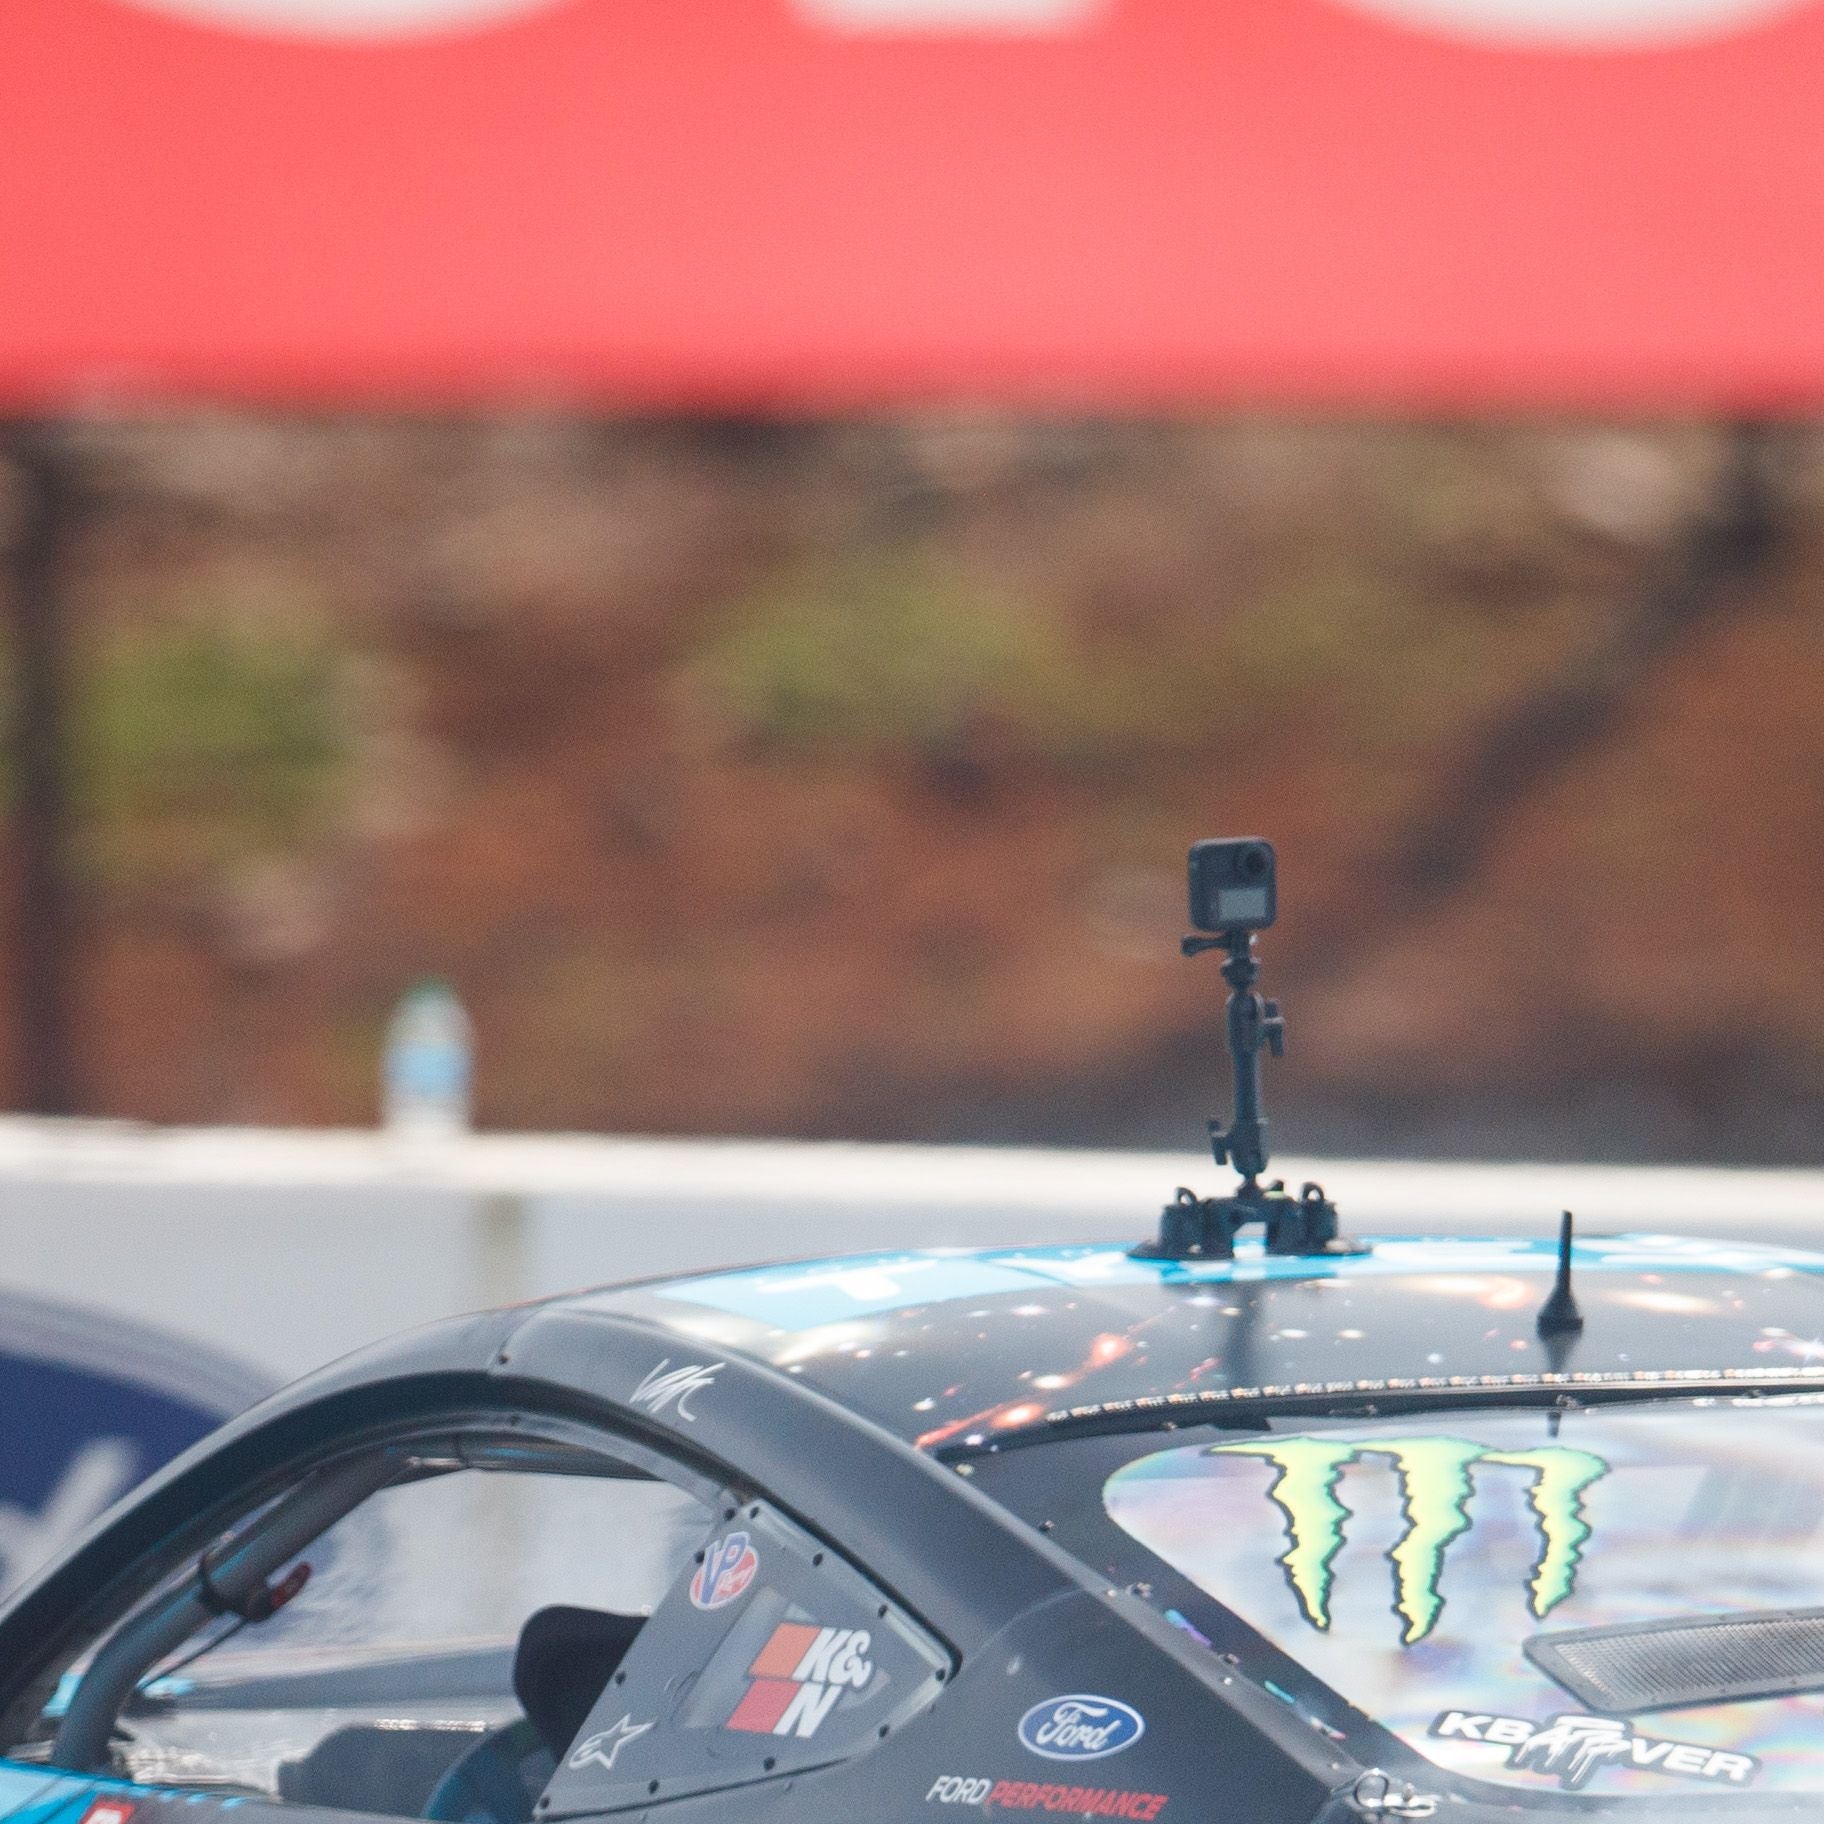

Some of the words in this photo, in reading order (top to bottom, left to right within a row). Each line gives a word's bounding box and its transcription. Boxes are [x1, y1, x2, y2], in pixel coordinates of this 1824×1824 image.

[1036, 1701, 1121, 1750] Ford
[927, 1775, 992, 1804] FORD
[987, 1780, 1169, 1822] PERFORMANCE
